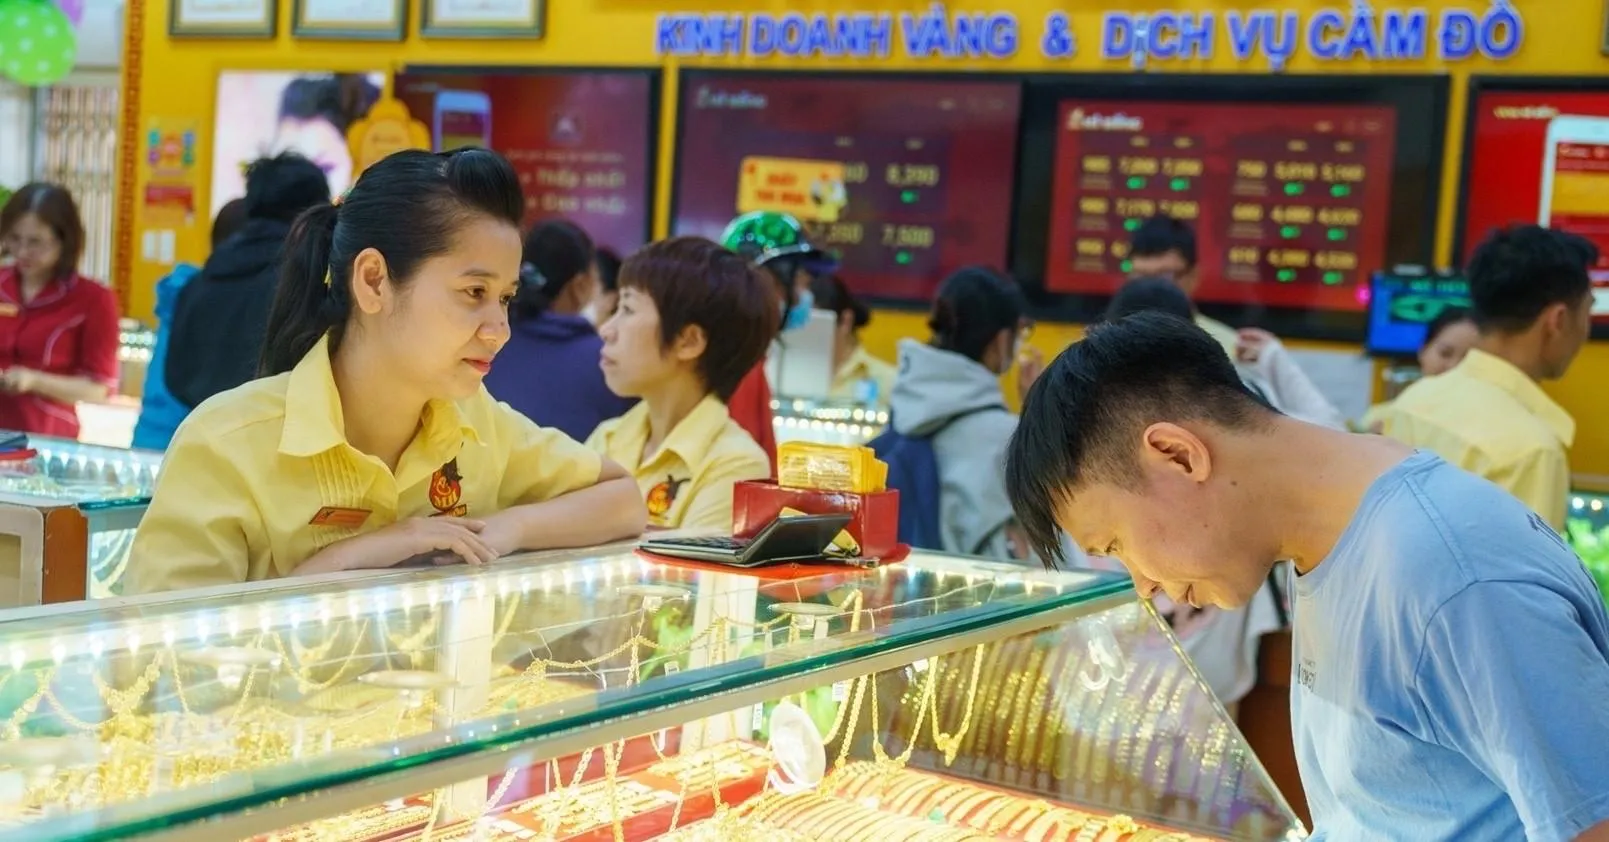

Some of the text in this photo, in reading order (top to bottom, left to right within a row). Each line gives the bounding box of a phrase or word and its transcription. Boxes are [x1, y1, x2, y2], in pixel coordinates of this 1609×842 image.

[657, 12, 742, 56] KINH
[750, 12, 891, 57] DOANH
[902, 2, 1018, 57] VÀNG
[1042, 13, 1075, 57] &
[1102, 11, 1214, 68] DỊCH
[1228, 11, 1299, 72] VỤ
